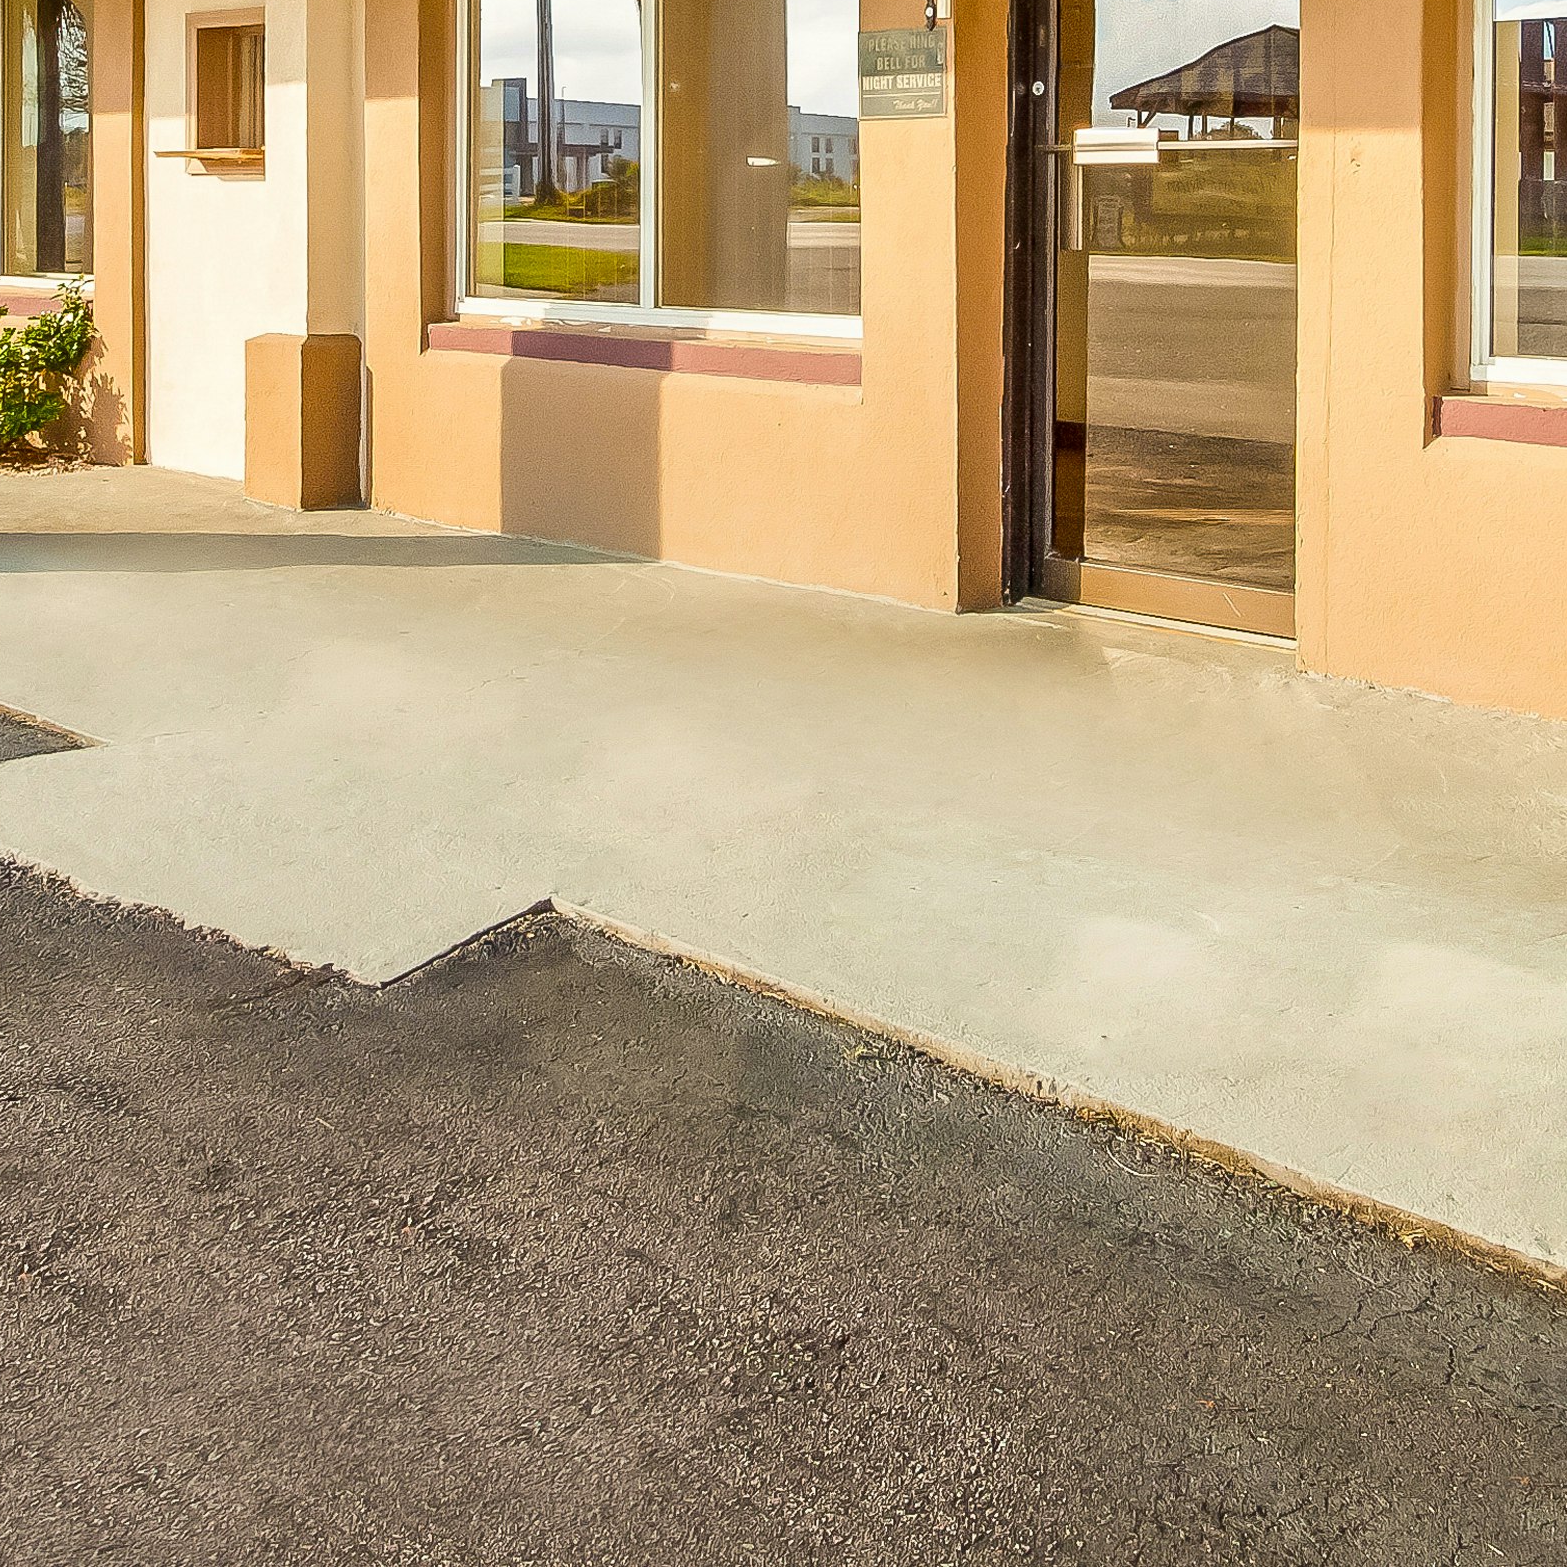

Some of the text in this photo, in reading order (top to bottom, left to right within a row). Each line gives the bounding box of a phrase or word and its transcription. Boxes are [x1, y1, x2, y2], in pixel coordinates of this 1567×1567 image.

[868, 37, 905, 52] PLEASE
[876, 55, 926, 70] BELL FOR
[862, 73, 942, 90] NIGHT SERVICE
